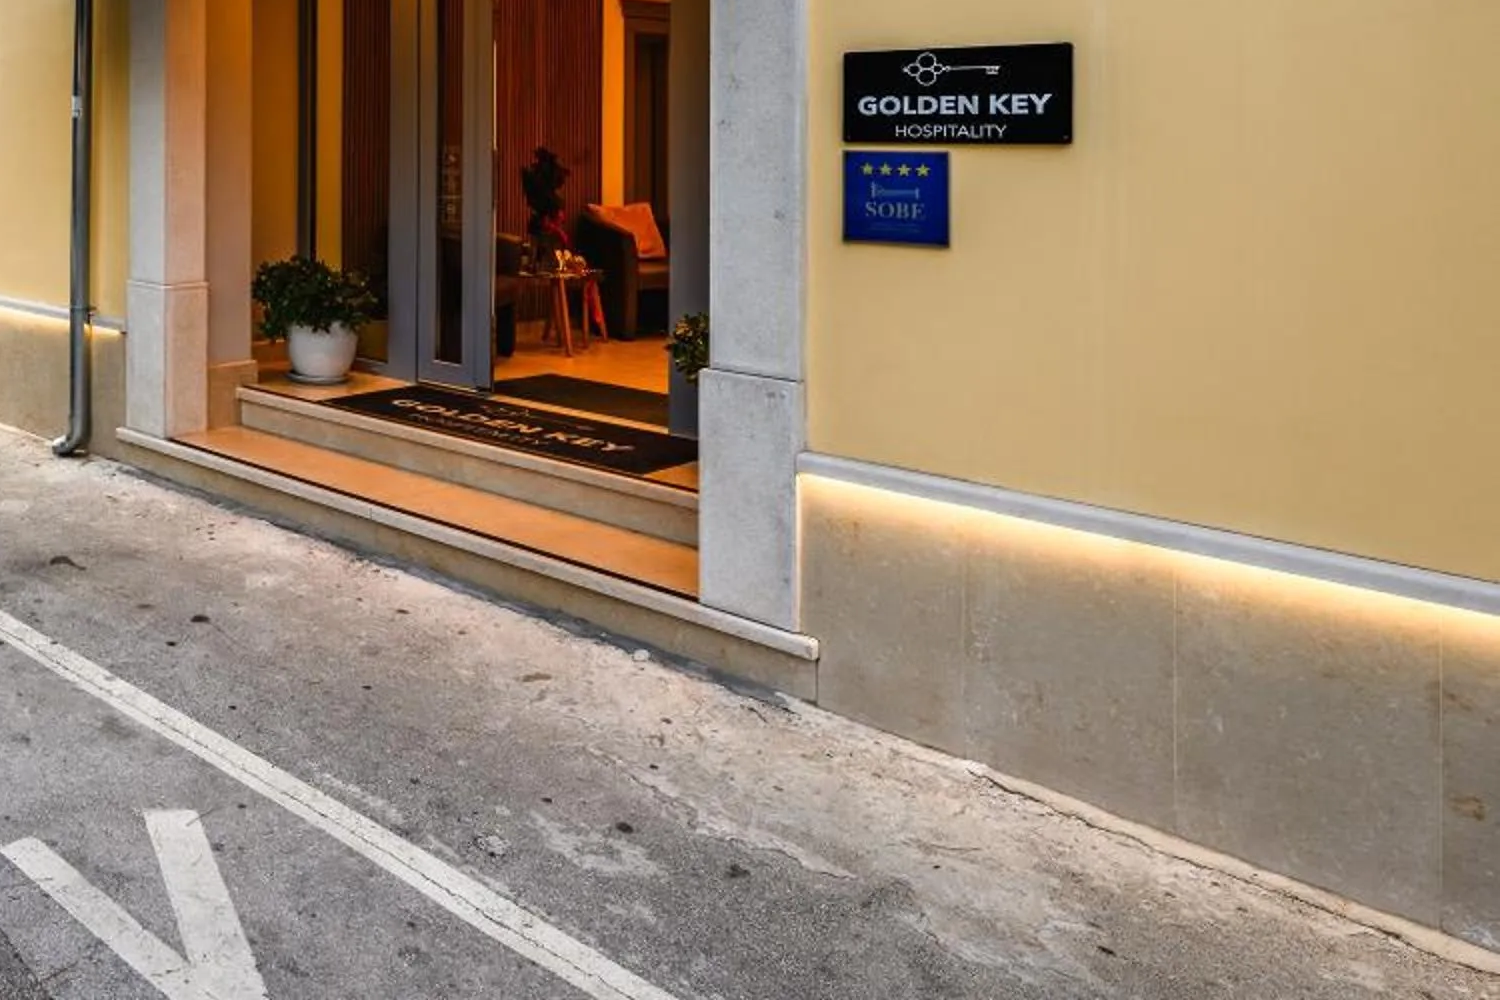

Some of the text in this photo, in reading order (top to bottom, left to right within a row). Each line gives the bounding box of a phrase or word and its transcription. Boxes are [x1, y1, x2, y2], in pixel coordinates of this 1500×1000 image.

[858, 94, 1052, 116] GOLDEN KEY
[895, 124, 1007, 138] HOSPITALITY
[865, 201, 926, 220] SOBE
